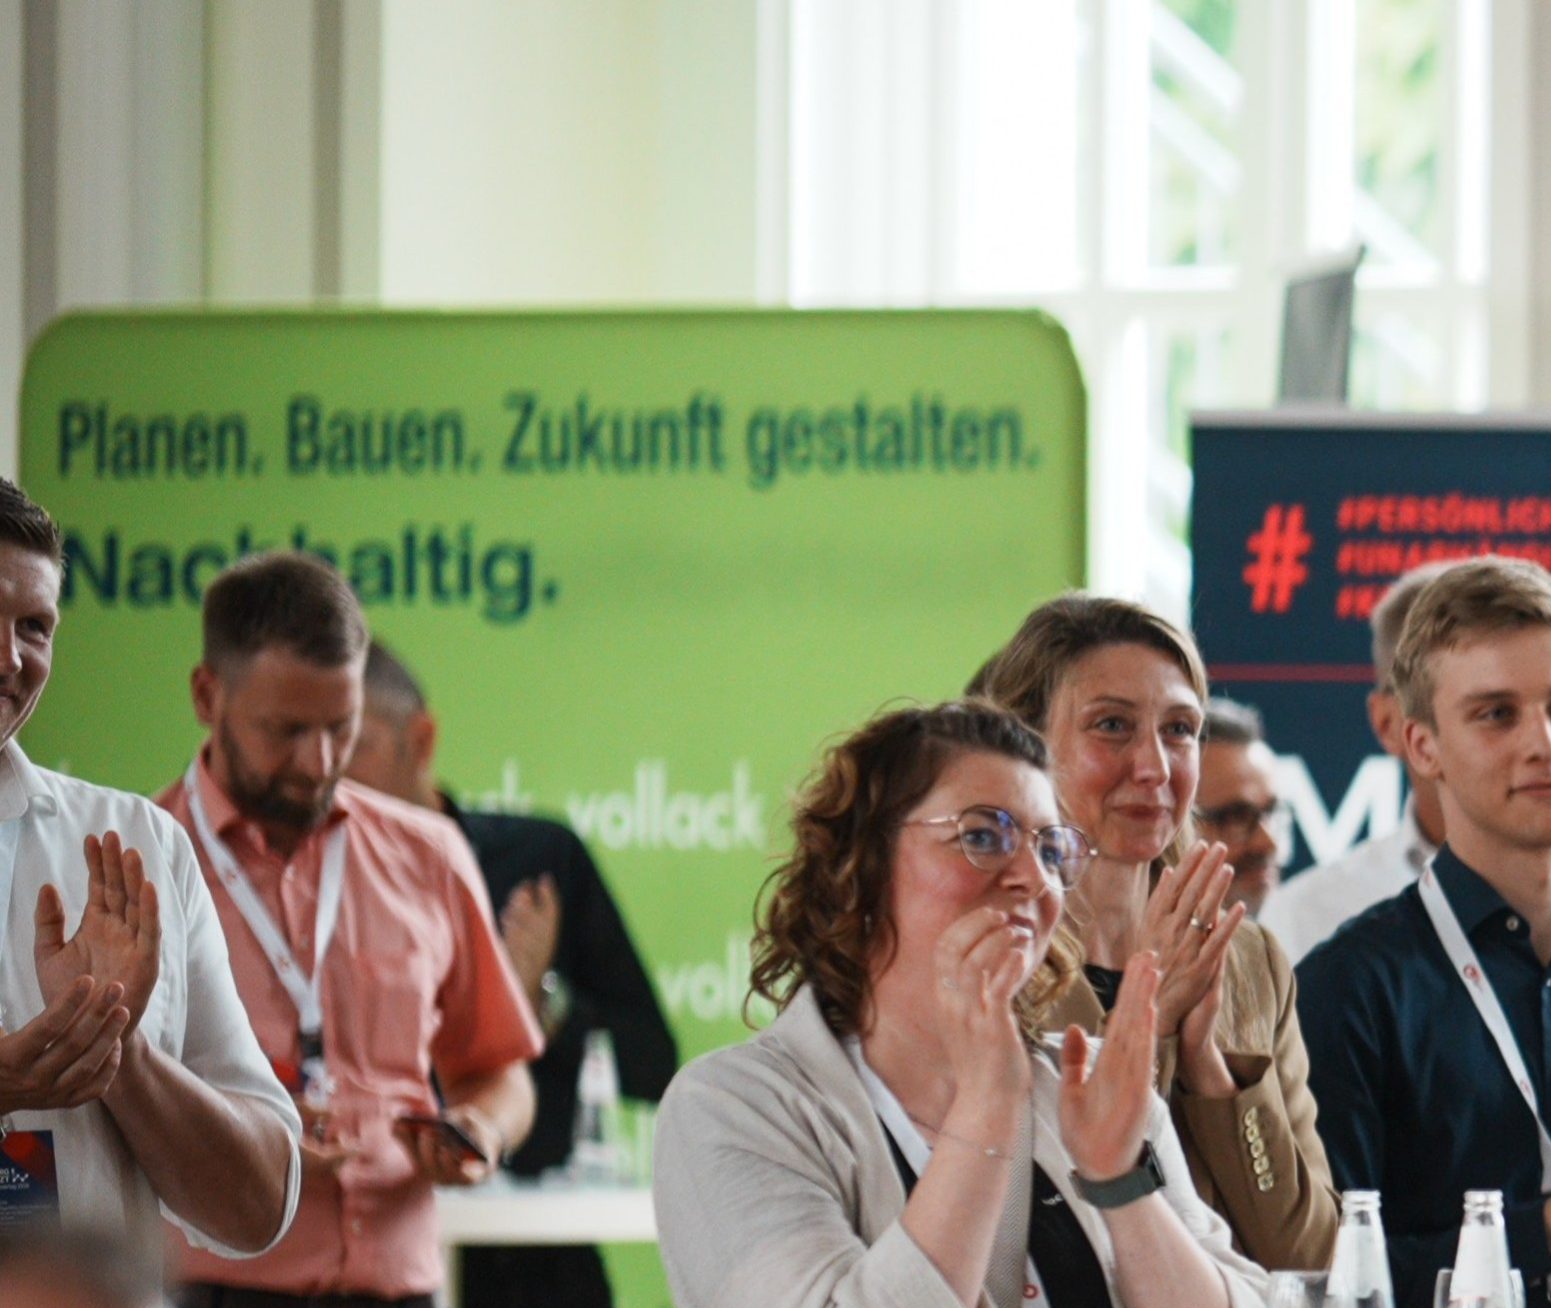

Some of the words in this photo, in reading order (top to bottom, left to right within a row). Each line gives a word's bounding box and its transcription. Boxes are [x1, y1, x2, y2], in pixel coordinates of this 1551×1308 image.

[56, 397, 264, 480] Planen.
[285, 392, 484, 476] Bauen.
[501, 389, 728, 476] Zukunft
[744, 390, 1042, 490] gestalten.
[60, 521, 559, 627] Nacaltig.
